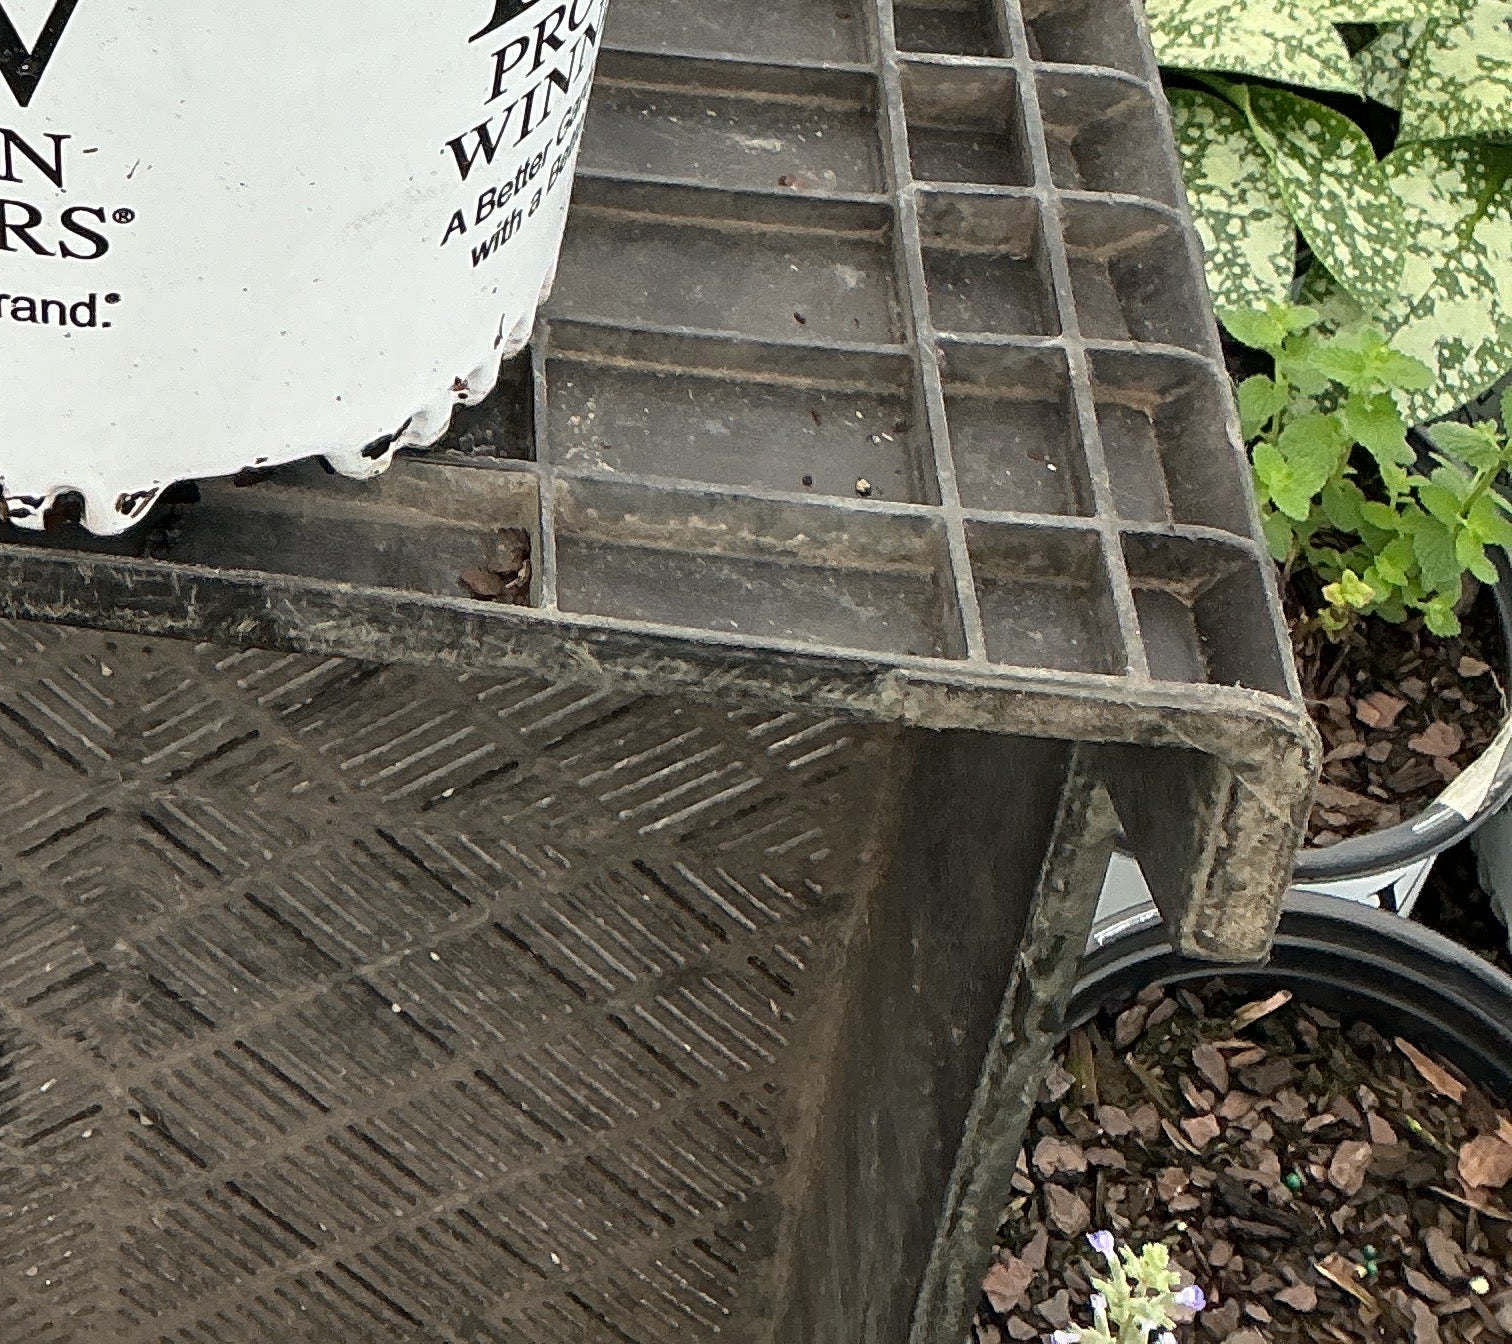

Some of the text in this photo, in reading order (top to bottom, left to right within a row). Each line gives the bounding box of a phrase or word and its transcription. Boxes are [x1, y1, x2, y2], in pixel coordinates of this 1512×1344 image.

[441, 208, 468, 247] A
[475, 138, 554, 226] Better
[471, 208, 523, 268] with
